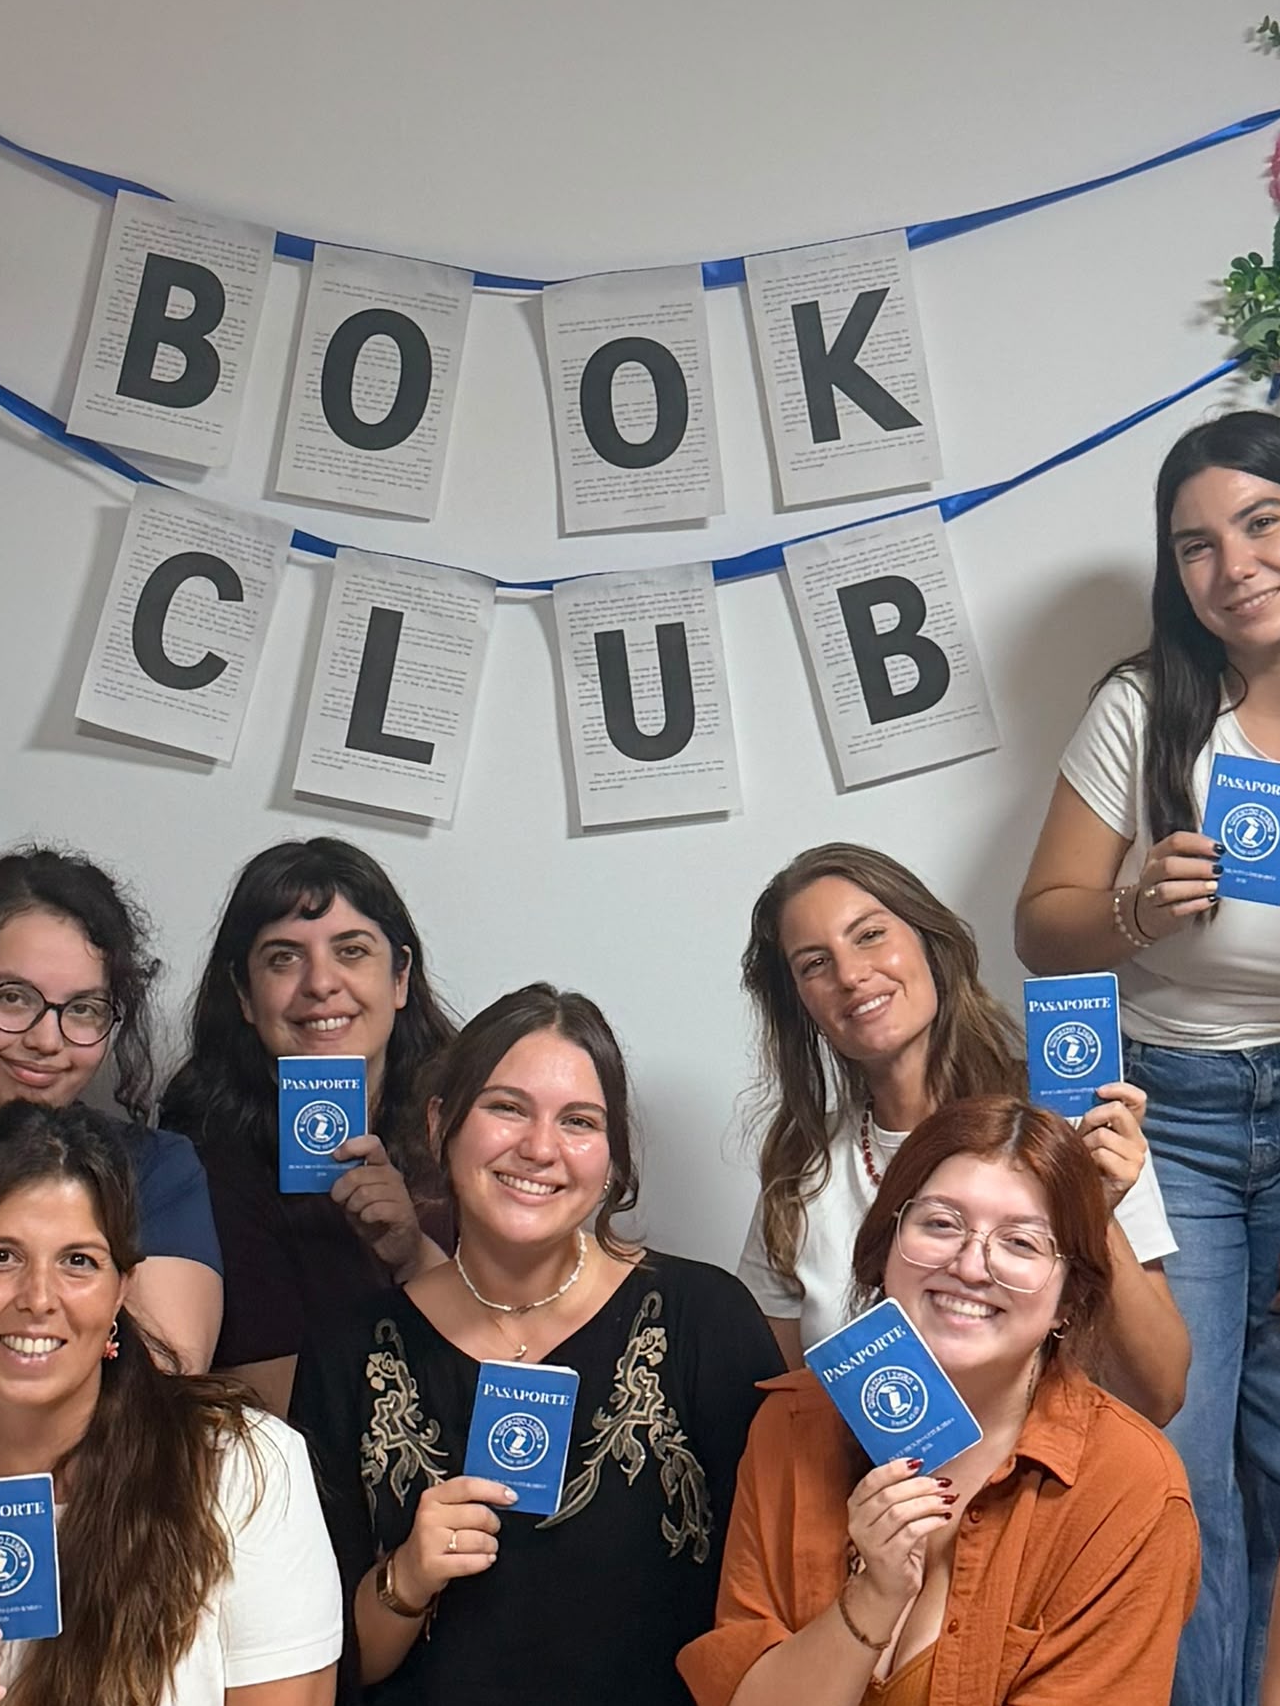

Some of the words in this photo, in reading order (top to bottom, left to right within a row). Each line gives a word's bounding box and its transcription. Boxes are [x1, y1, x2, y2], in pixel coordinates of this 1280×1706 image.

[116, 252, 921, 469] BOOK
[130, 551, 951, 764] CLUB
[1028, 997, 1111, 1012] PASAPORTE
[282, 1078, 360, 1090] PASAPORTE
[822, 1325, 907, 1383] PASAPORTE
[484, 1383, 570, 1406] PASAPORTE
